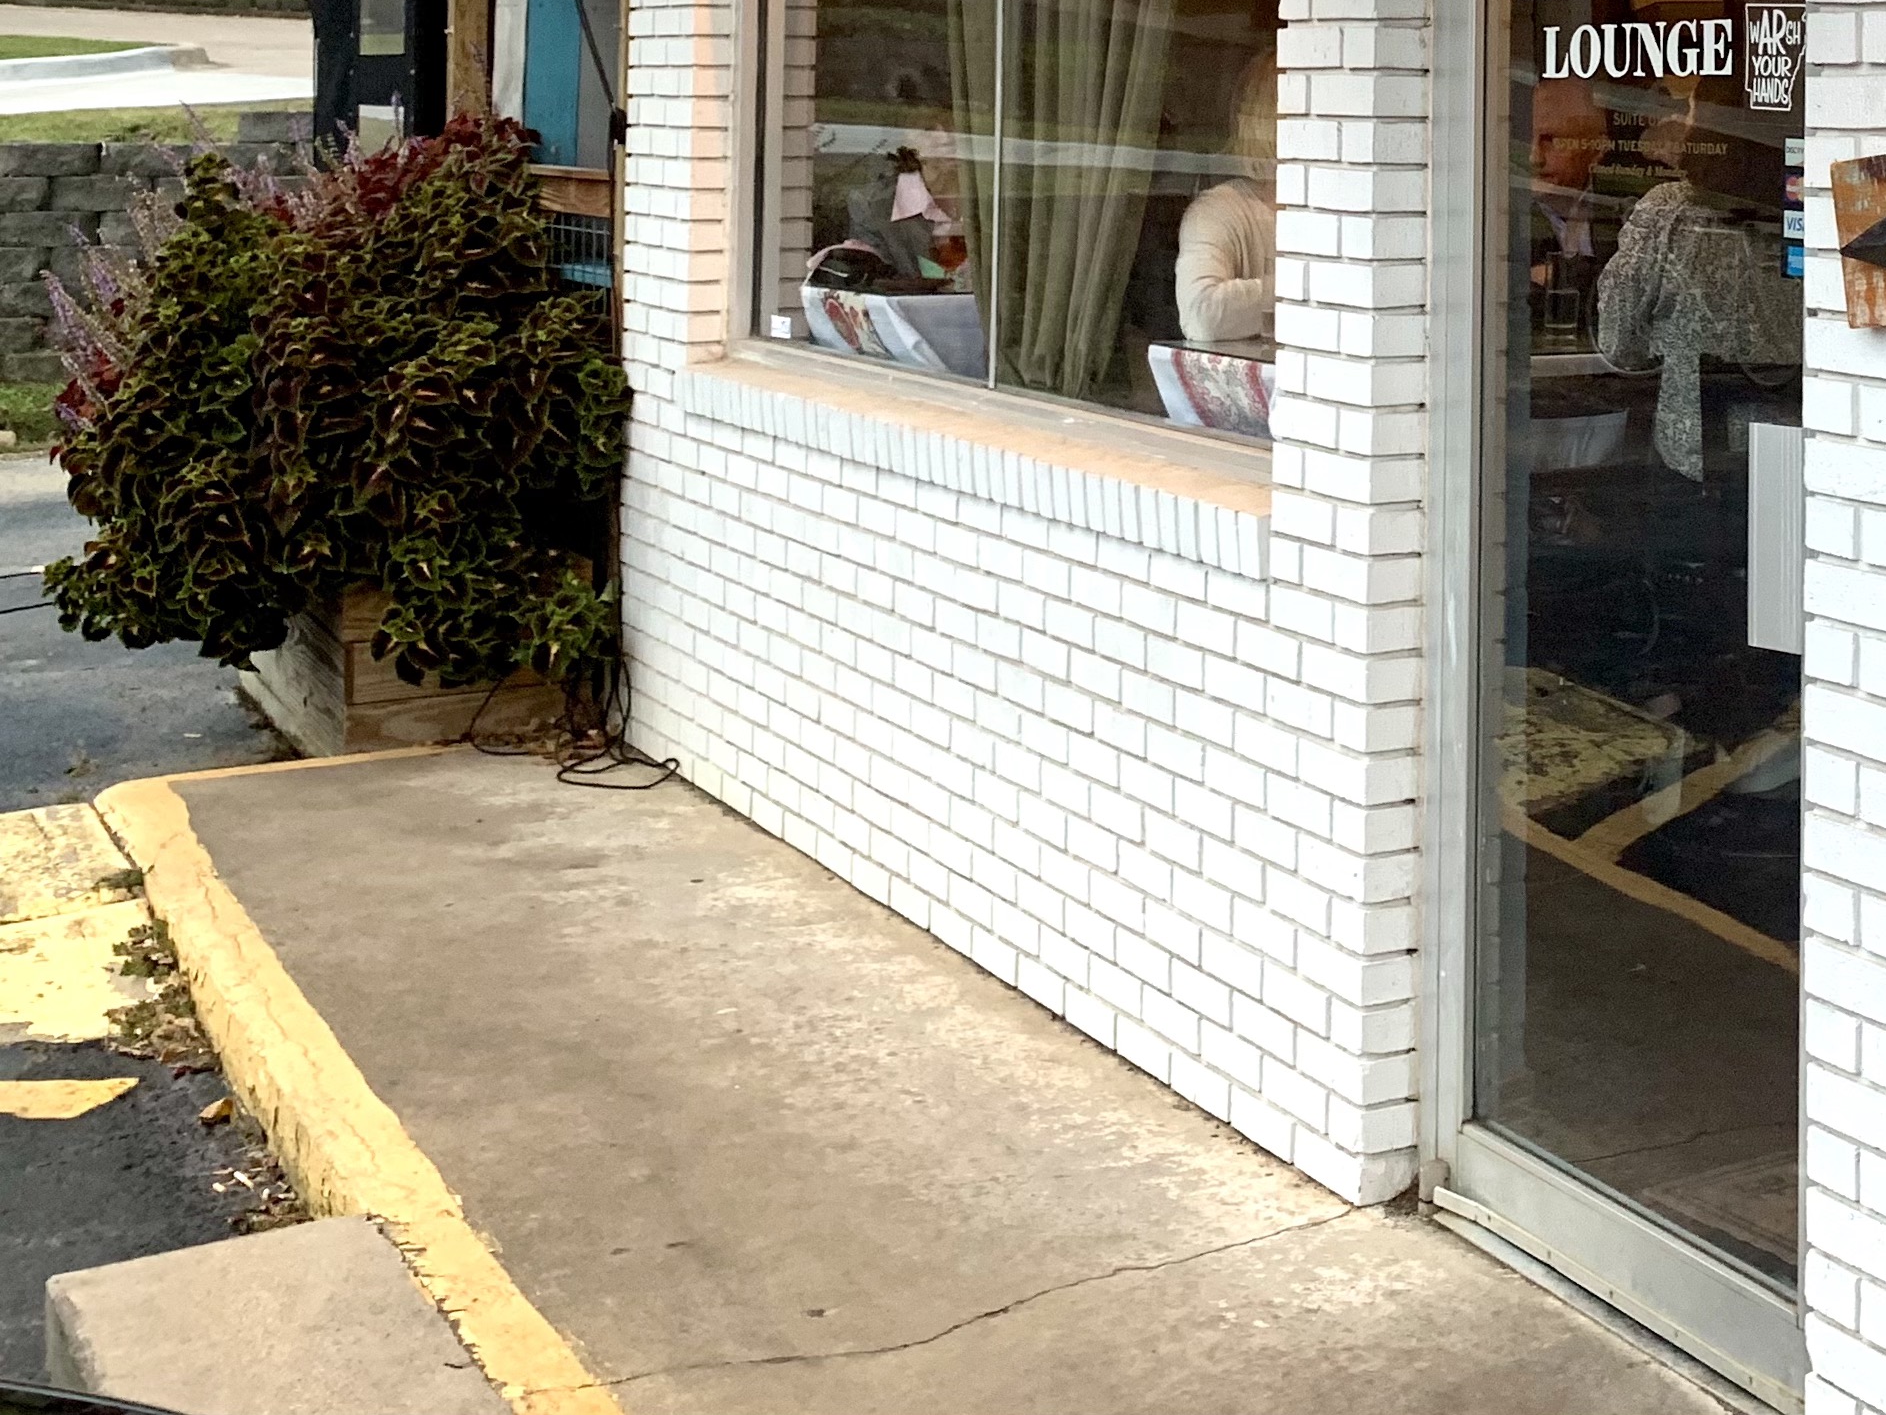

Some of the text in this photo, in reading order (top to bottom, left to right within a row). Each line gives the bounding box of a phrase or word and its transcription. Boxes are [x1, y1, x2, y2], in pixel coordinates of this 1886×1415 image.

[1749, 9, 1800, 55] WARSH
[1542, 19, 1733, 79] LOUNGE
[1752, 55, 1792, 77] YOUR
[1753, 77, 1789, 105] HANDS
[1613, 112, 1645, 126] SUITE
